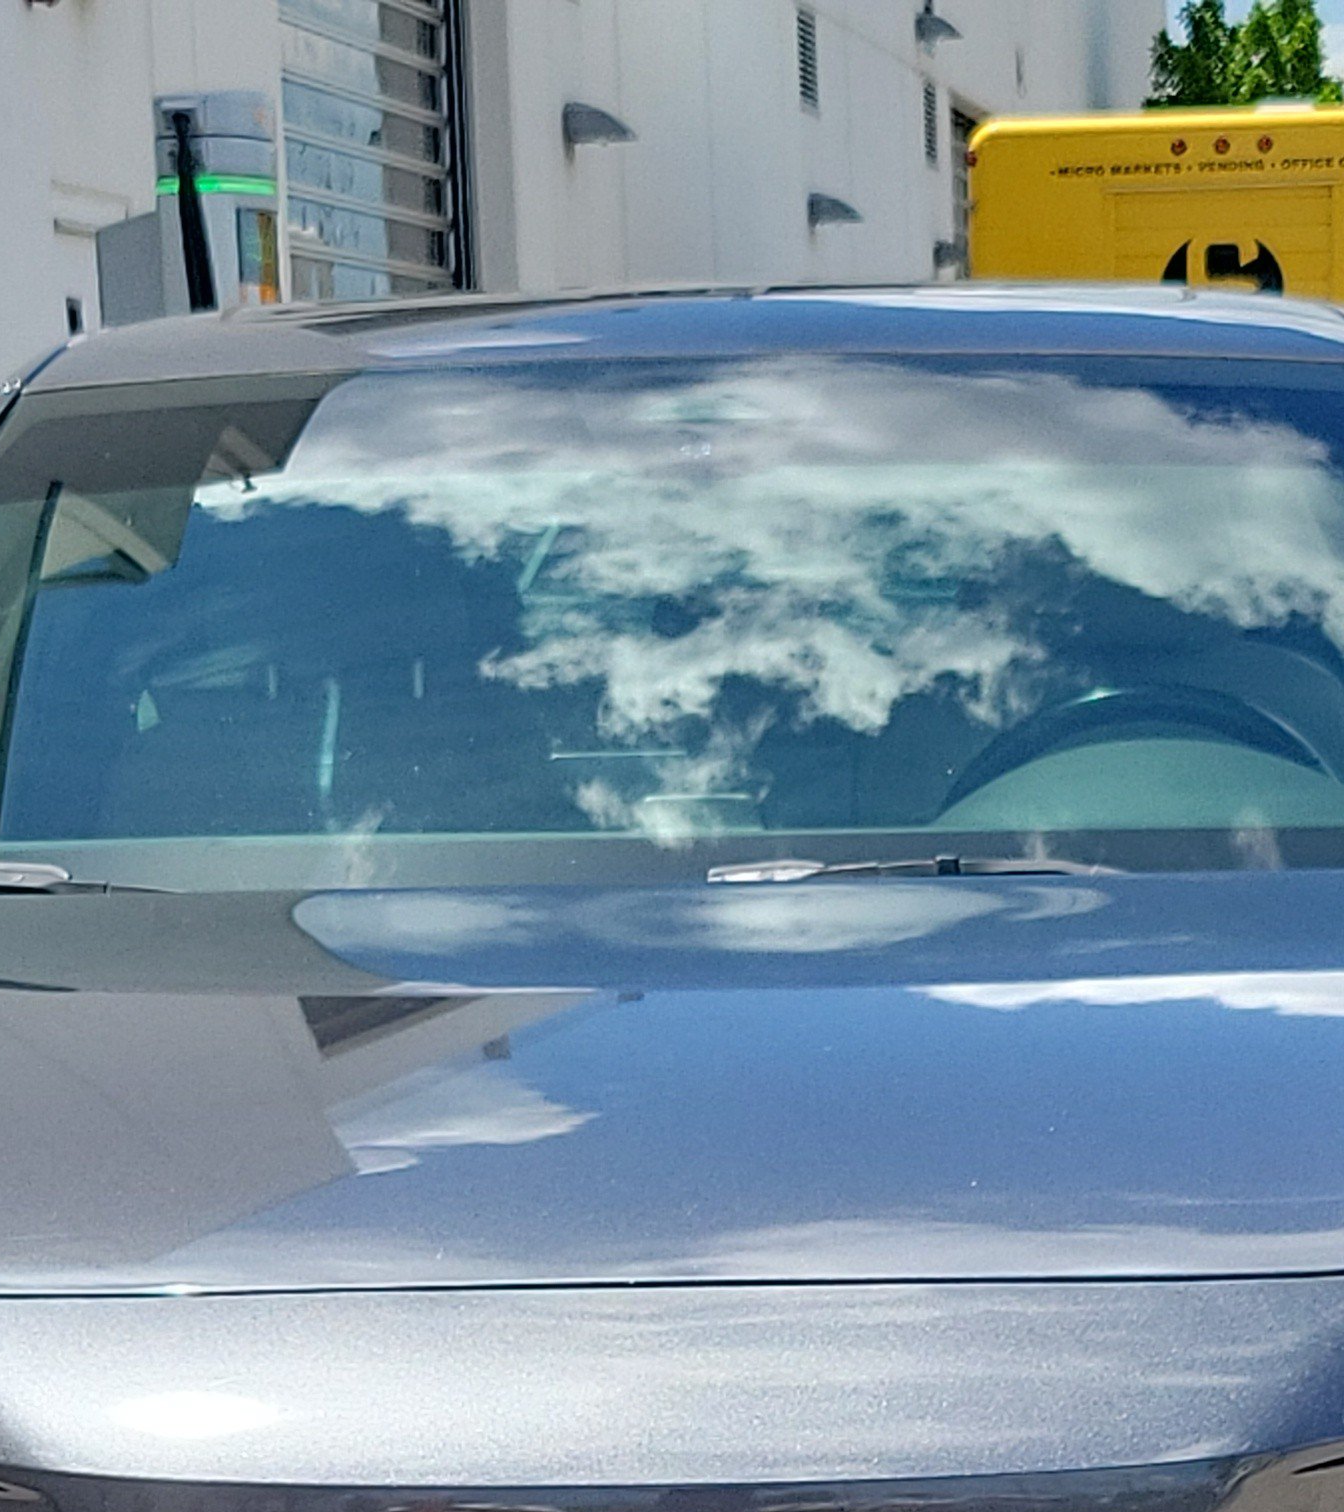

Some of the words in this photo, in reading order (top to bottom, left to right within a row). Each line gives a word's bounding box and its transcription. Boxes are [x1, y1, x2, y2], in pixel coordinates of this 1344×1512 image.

[1058, 164, 1105, 176] MICRO
[1110, 162, 1181, 175] MARKETS
[1197, 158, 1264, 172] VENDING
[1280, 156, 1334, 170] OFFICE
